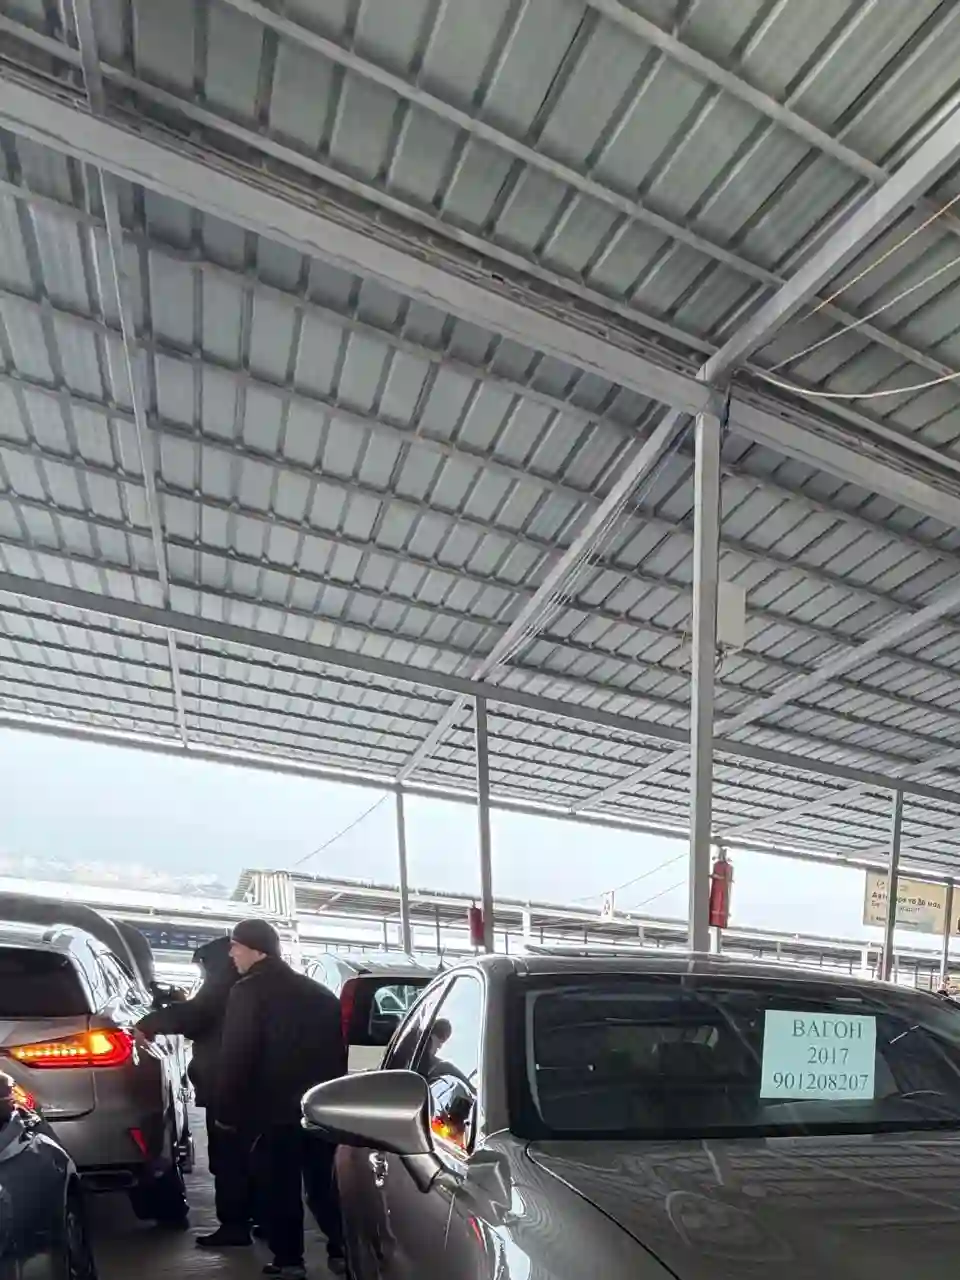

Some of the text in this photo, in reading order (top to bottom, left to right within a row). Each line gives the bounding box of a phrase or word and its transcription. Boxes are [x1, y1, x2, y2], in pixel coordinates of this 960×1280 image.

[792, 1019, 863, 1039] ВАГОН
[807, 1046, 849, 1065] 2017
[773, 1071, 869, 1091] 901208207
